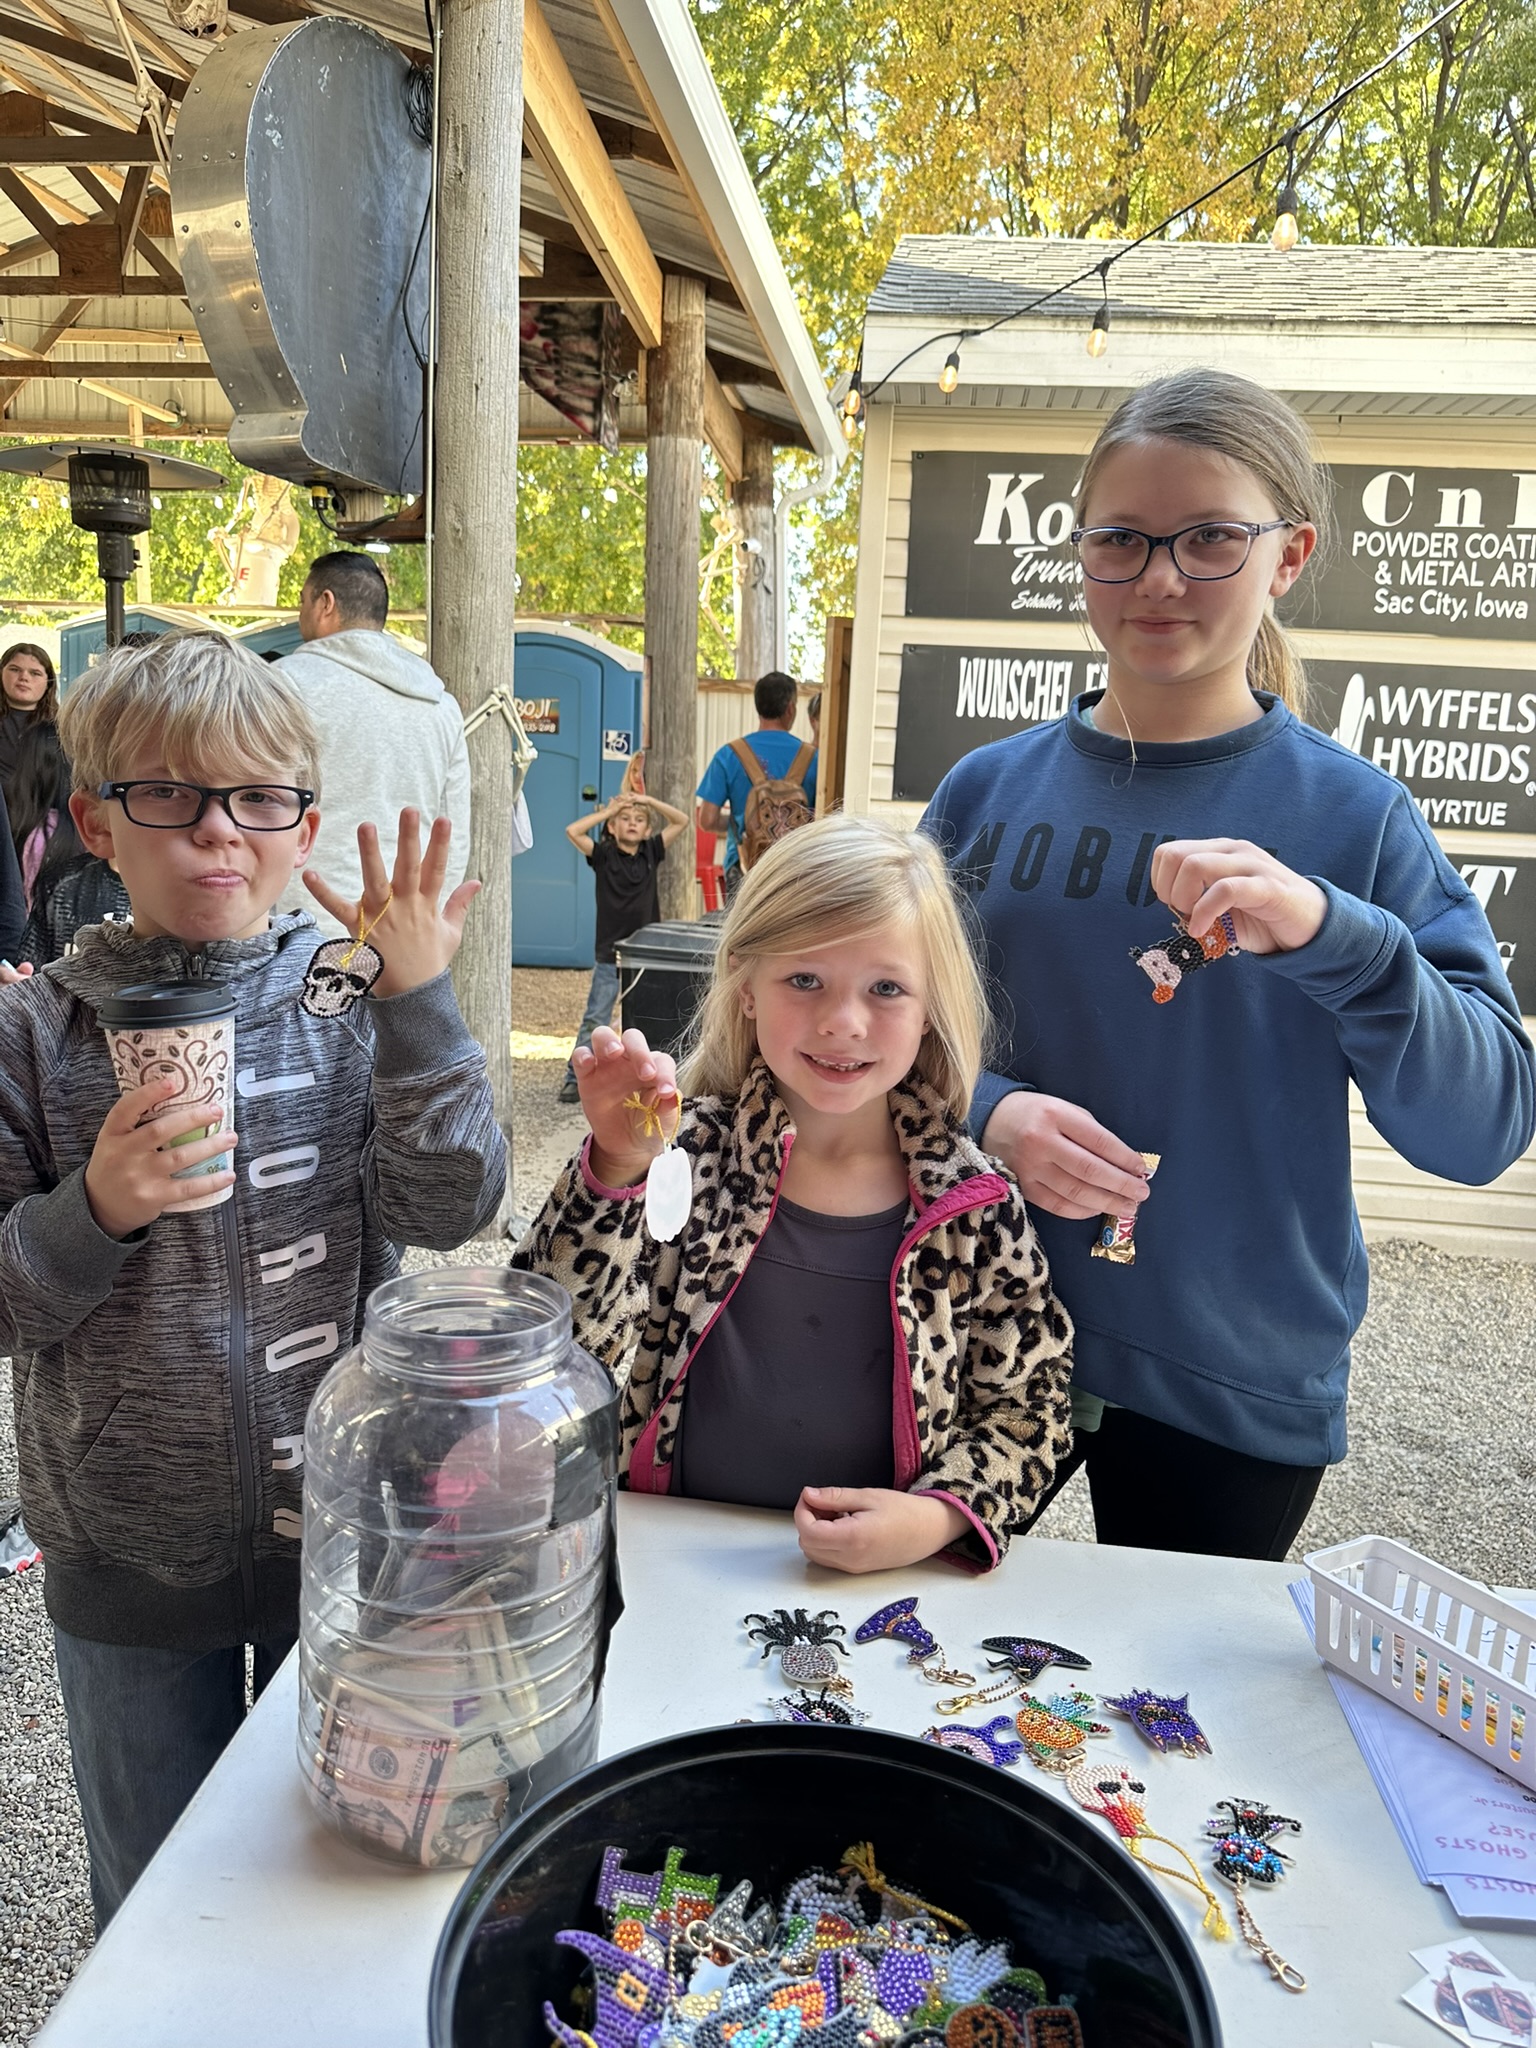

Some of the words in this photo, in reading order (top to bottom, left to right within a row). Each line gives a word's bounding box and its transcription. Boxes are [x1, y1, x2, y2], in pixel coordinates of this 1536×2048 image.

[1362, 471, 1415, 527] C
[1434, 488, 1485, 528] n
[1352, 531, 1459, 559] POWDER
[1374, 559, 1392, 585] &
[1400, 560, 1484, 587] METAL
[1373, 588, 1414, 614] Sac
[1419, 589, 1468, 622] City,
[1475, 591, 1528, 619] Iowa
[955, 657, 1073, 721] WUNSCHEL
[1379, 685, 1536, 734] WYFFELS
[1372, 736, 1531, 784] HYBRIDS
[1435, 1835, 1528, 1860] GHOSTS
